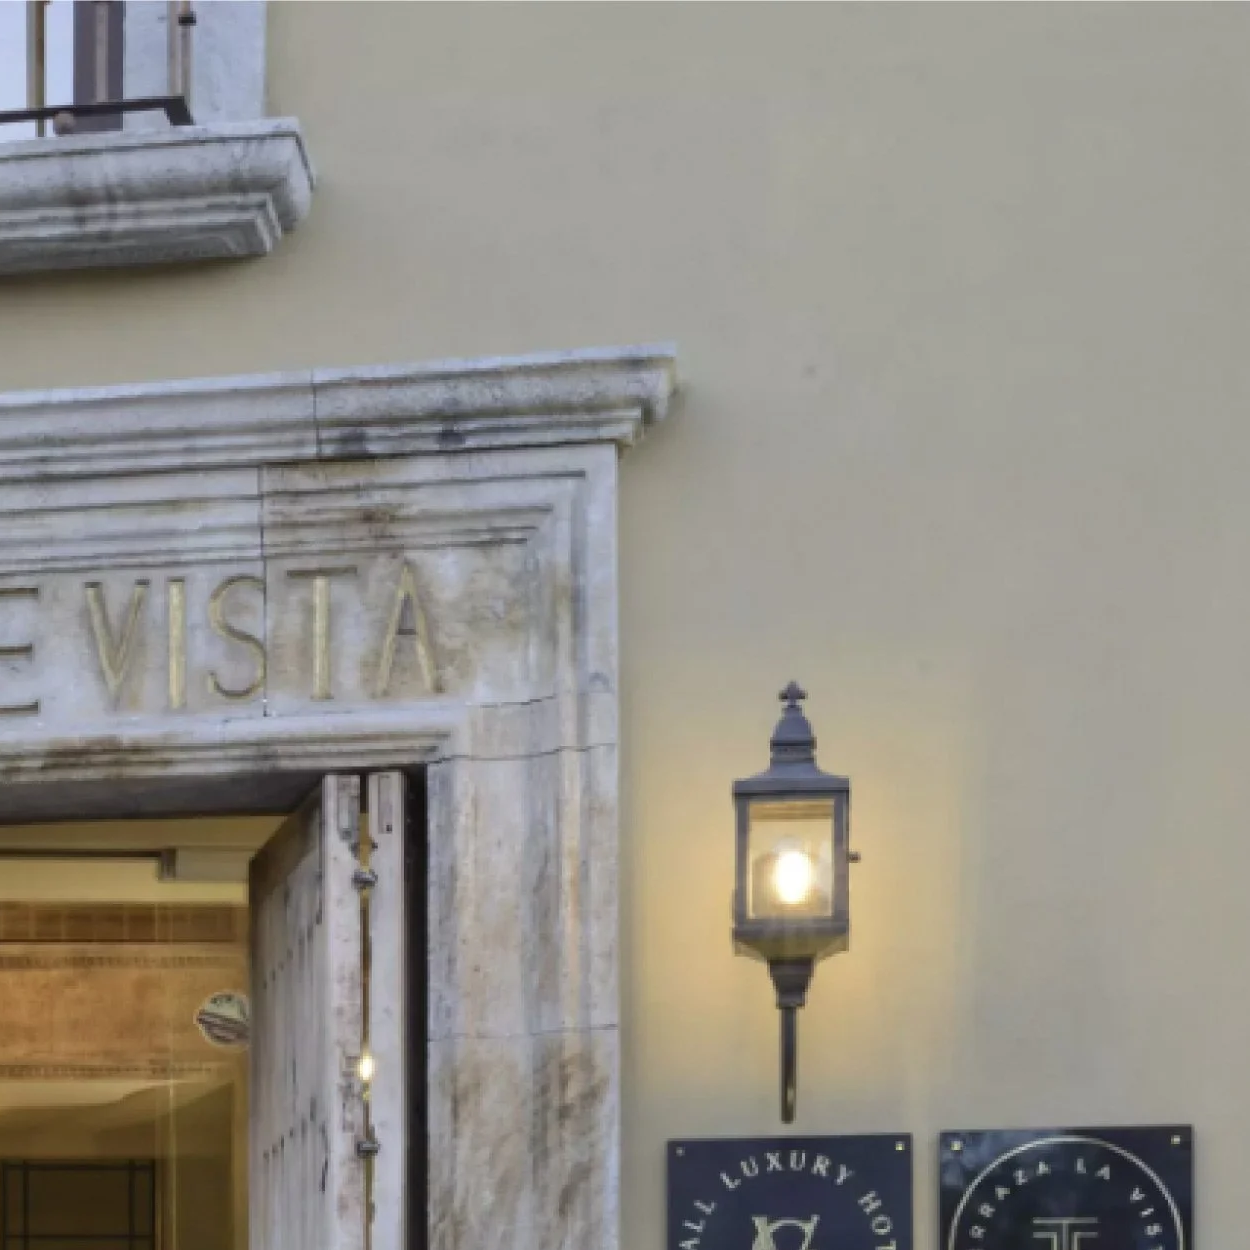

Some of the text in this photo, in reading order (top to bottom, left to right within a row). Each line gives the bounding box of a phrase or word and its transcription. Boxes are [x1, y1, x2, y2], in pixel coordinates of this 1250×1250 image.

[84, 561, 445, 710] VISTA
[720, 1151, 855, 1190] LUXURY
[1075, 1157, 1111, 1181] LA
